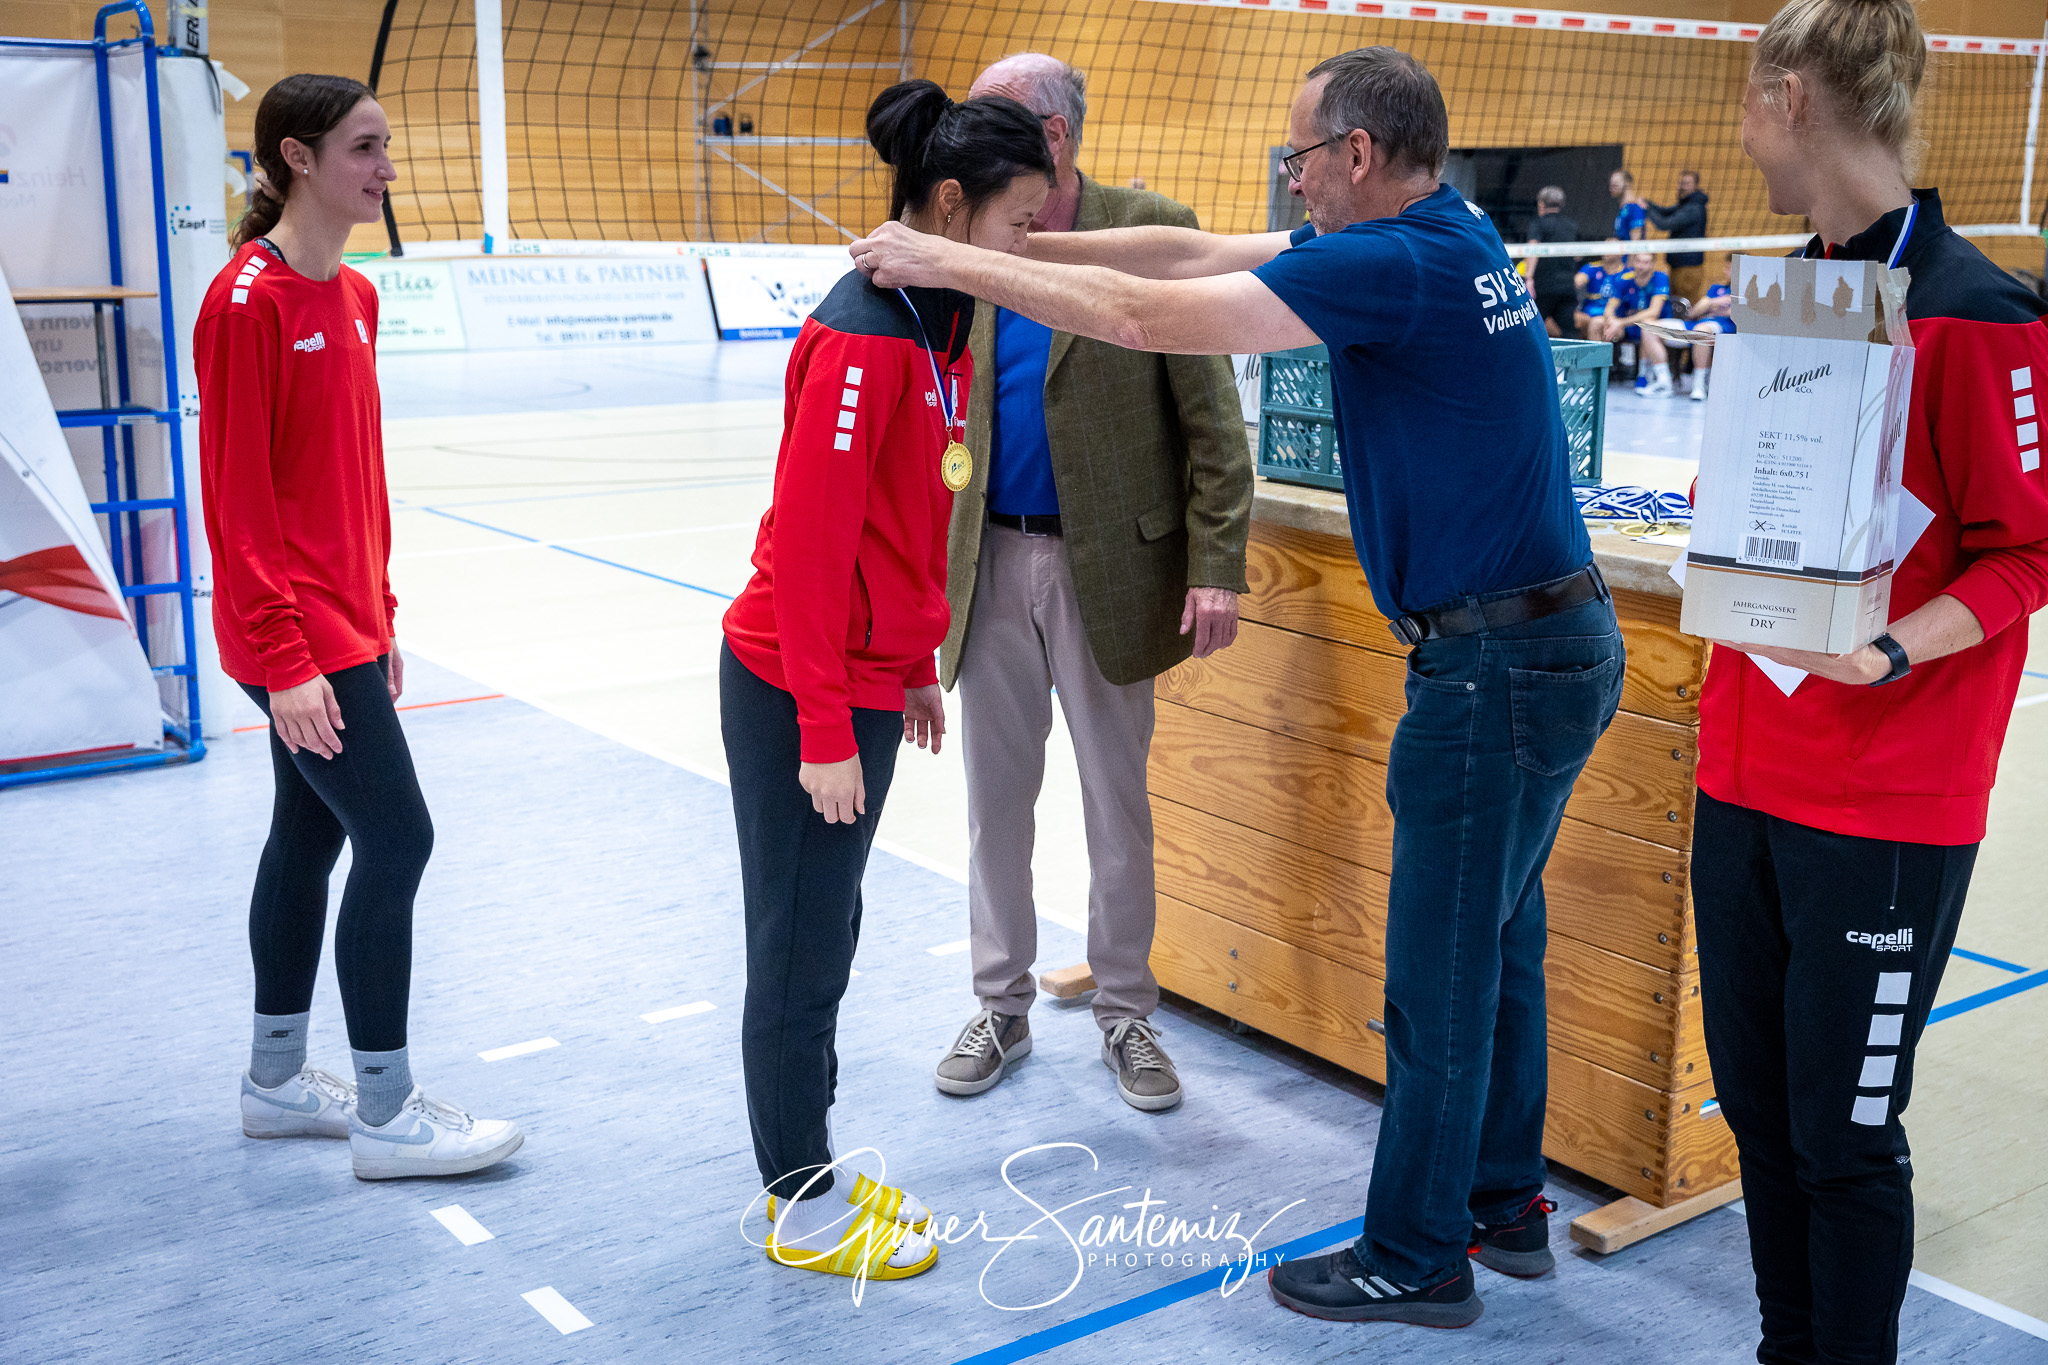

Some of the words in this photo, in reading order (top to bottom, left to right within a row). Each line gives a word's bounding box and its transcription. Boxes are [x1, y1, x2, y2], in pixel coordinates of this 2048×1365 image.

[690, 247, 731, 257] FUCHS
[467, 264, 568, 287] MEINCKE
[575, 262, 592, 284] &
[598, 258, 690, 283] PARTNER
[1474, 271, 1508, 309] SV
[1758, 364, 1832, 399] Mumm
[1759, 431, 1782, 440] SEKT
[1758, 441, 1776, 449] DRY
[1754, 466, 1778, 476] Inhalt:
[1733, 600, 1797, 614] JAHRGANGSSEKT
[1750, 618, 1776, 629] DRY
[1846, 928, 1912, 949] capelli
